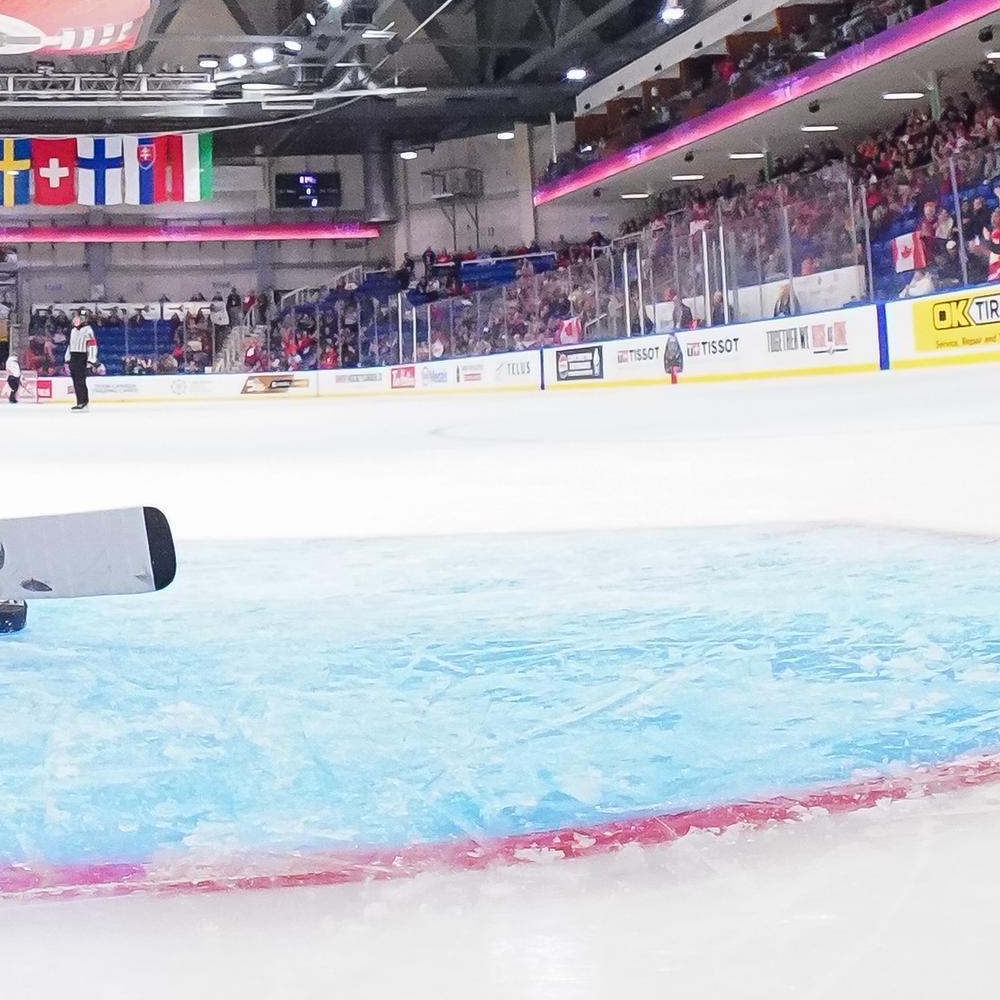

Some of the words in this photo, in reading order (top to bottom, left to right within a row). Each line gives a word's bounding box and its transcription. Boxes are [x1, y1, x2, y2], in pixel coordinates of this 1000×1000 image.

[932, 298, 971, 331] OK
[629, 346, 660, 362] TISSOT
[701, 338, 740, 356] TISSOT
[507, 361, 532, 376] TELUS
